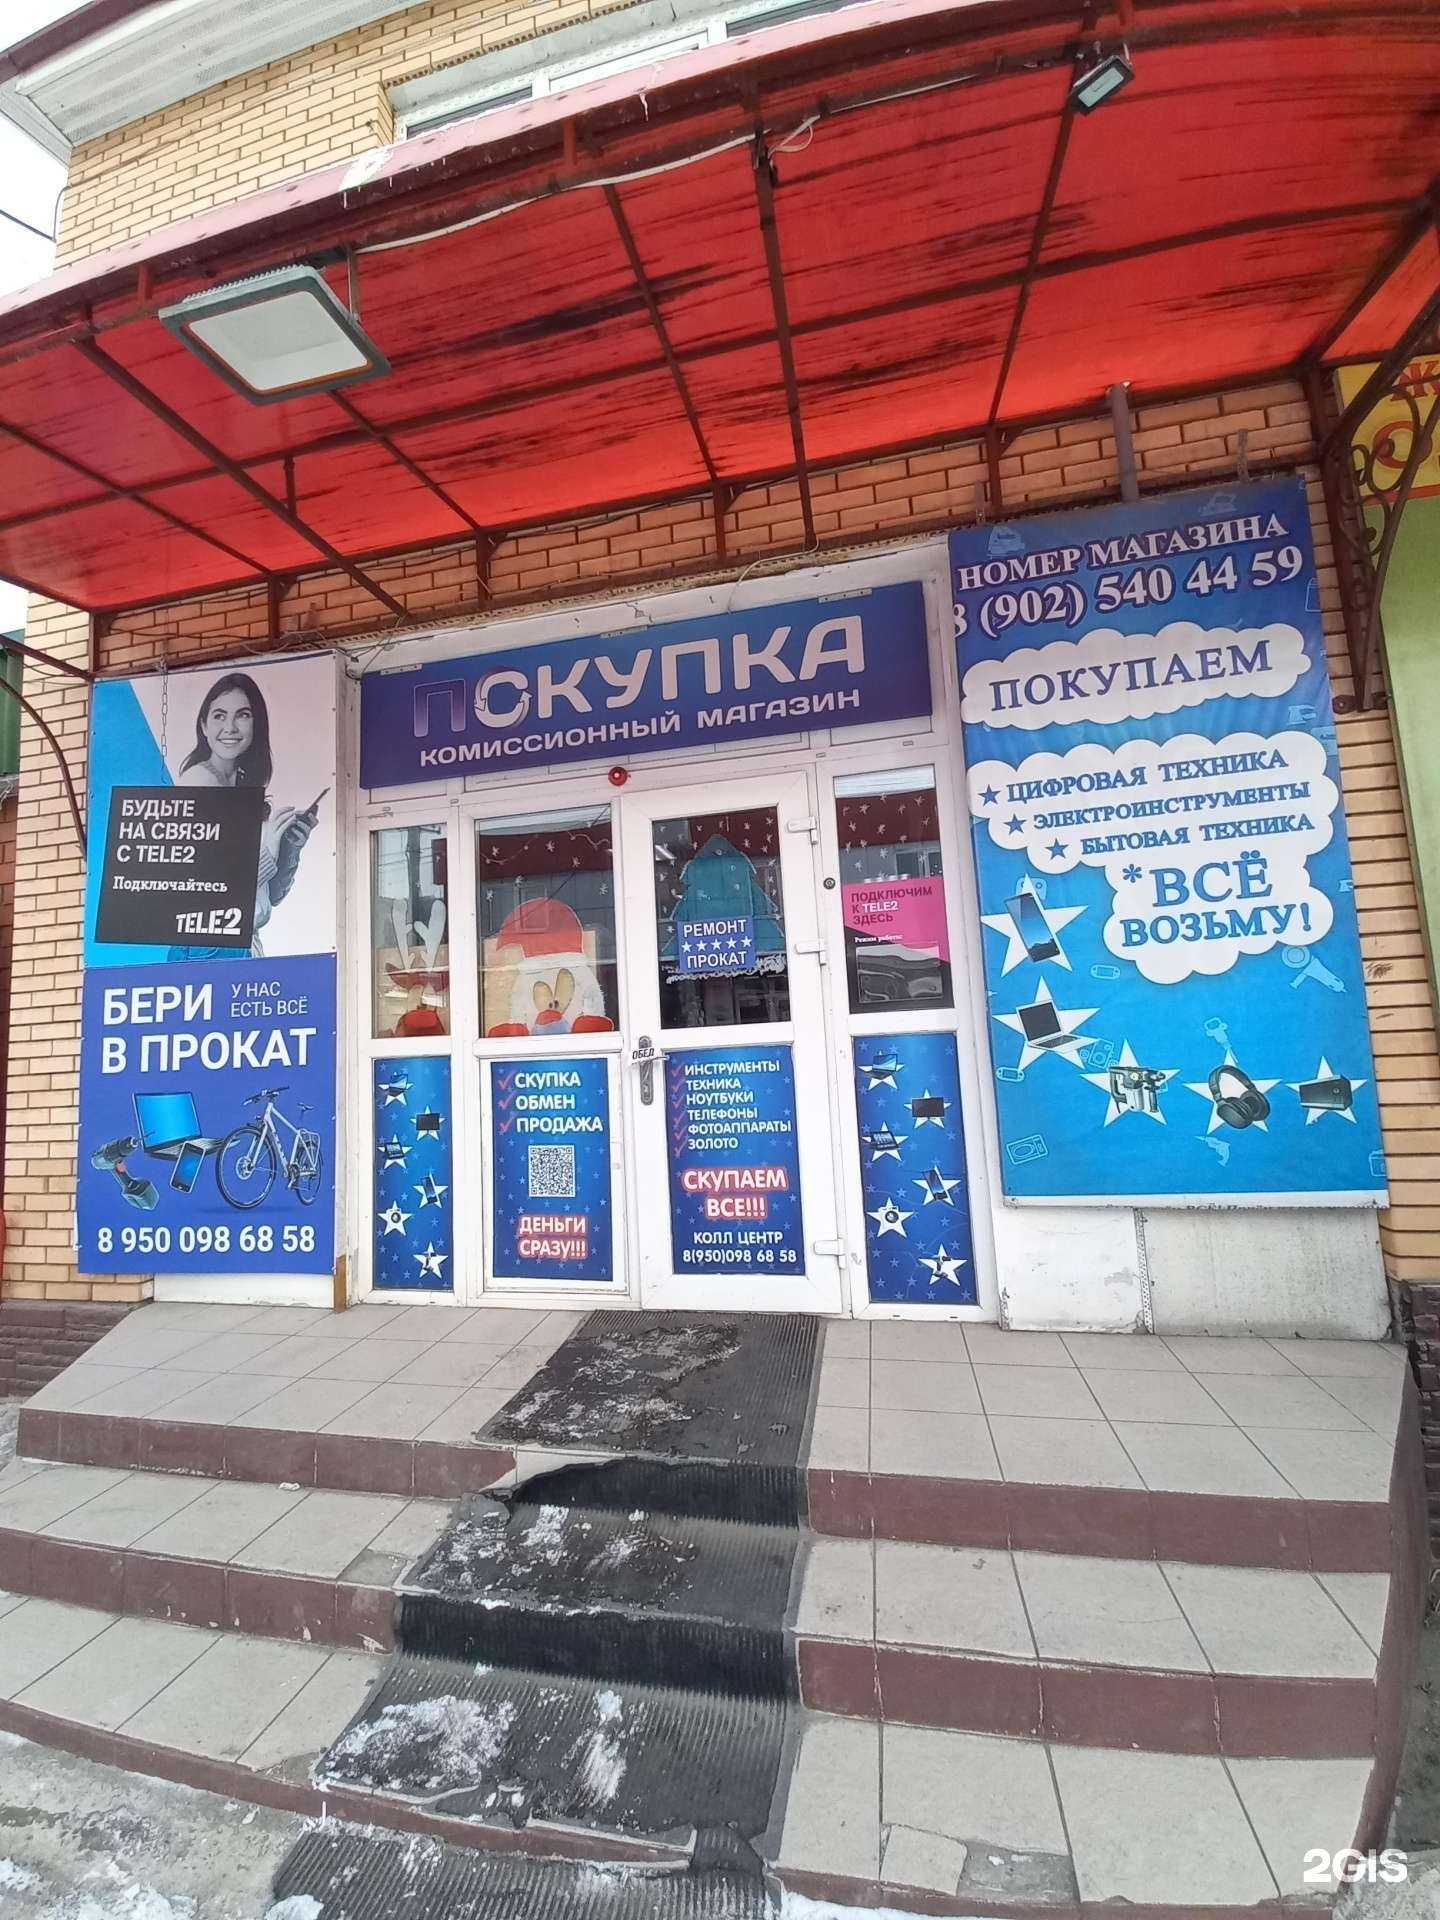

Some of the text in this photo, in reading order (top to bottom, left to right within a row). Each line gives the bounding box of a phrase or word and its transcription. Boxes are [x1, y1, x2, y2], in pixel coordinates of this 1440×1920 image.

[958, 513, 1288, 590] НОМЕР МАГАЗИНА
[980, 583, 1085, 637] (902)
[1098, 568, 1172, 611] 540
[1187, 560, 1237, 594] 44
[1251, 545, 1303, 586] 59
[988, 640, 1272, 711] ПОКУПАЕМ
[420, 689, 860, 767] КОМИССИОННЫЙ МАГАЗИН
[1007, 749, 1288, 805] ЦИФРОВАЯ ТЕХНИКА
[122, 799, 195, 820] БУДЬТЕ
[1033, 782, 1311, 829] ЭЛЕКТРОИНСТРУМЕНТЫ
[119, 822, 220, 841] НА СВЯЗИ
[1081, 814, 1314, 855] БЫТОВАЯ ТЕХНИКА
[116, 845, 195, 864] С TELE2
[112, 876, 228, 893] Подключайтесь
[851, 887, 933, 903] ПОДКЛЮЧИМ
[852, 900, 899, 914] К TELE2
[176, 907, 242, 935] TELE2
[683, 919, 747, 938] РЕМОНТ
[853, 913, 894, 926] ЗДЕСЬ
[1120, 902, 1312, 947] ВОЗЬМУ!
[687, 951, 747, 969] ПРОКАТ
[231, 981, 281, 998] У НАС
[103, 983, 213, 1026] БЕРИ
[230, 996, 308, 1018] ЕСТЬ ВСЁ
[101, 1027, 317, 1074] В ПРОКАТ
[684, 1060, 780, 1076] ИНСТРУМЕНТЫ
[514, 1071, 581, 1088] СКУПКА
[686, 1078, 741, 1091] ТЕХНИКА
[516, 1094, 576, 1110] ОБМЕН
[686, 1091, 754, 1105] НОУТБУКИ
[688, 1108, 758, 1121] ТЕЛЕФОНЫ
[516, 1117, 603, 1134] ПРОДАЖА
[688, 1121, 792, 1135] ФОТОАППАРАТЫ
[688, 1137, 738, 1150] ЗОЛОТО
[683, 1169, 787, 1191] СКУПАЕМ
[706, 1197, 766, 1217] ВСЕ!!!
[519, 1217, 586, 1235] ДЕНЬГИ
[98, 1226, 315, 1253] 8 950 098 68 58
[693, 1231, 784, 1246] КОЛЛ ЦЕНТР
[519, 1239, 586, 1258] СРАЗУ!!!
[683, 1249, 797, 1265] 8(950)098 68 58
